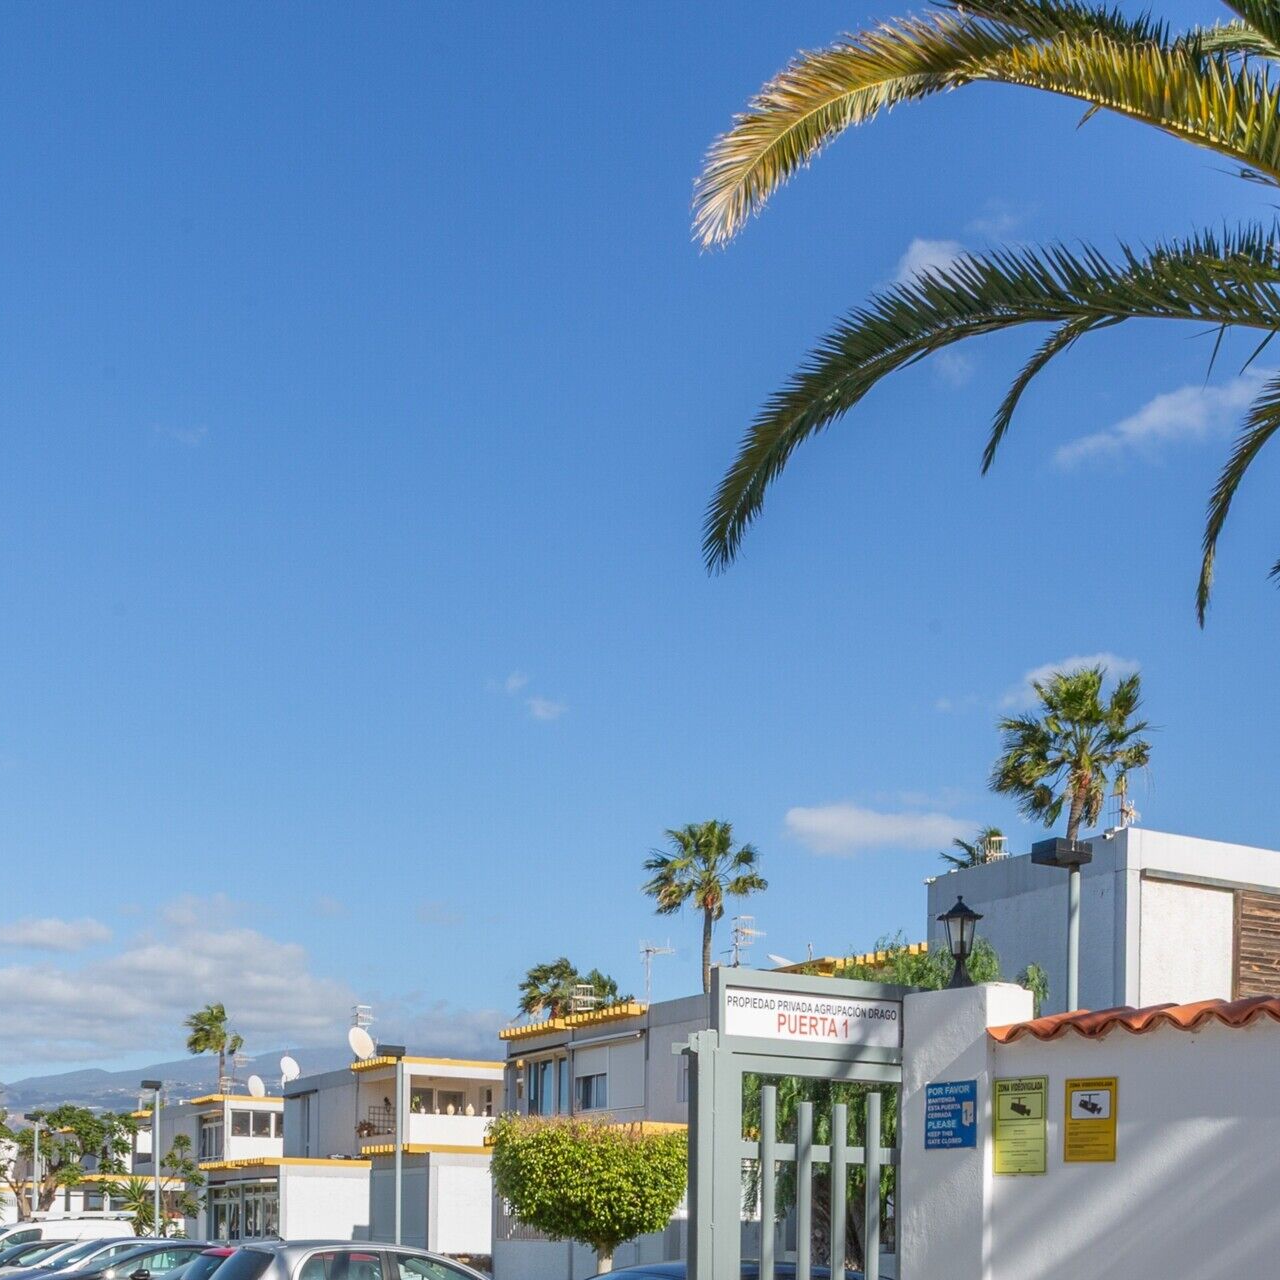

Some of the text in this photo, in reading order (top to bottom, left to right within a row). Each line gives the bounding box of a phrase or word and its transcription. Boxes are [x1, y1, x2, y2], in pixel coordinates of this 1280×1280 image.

[727, 995, 898, 1021] PROPIEDAD PRIVADA AGRUPACIÓN DRAGO
[777, 1013, 850, 1039] PUERTA 1
[927, 1085, 969, 1096] POR FAVOR
[927, 1120, 956, 1129] PLEASE
